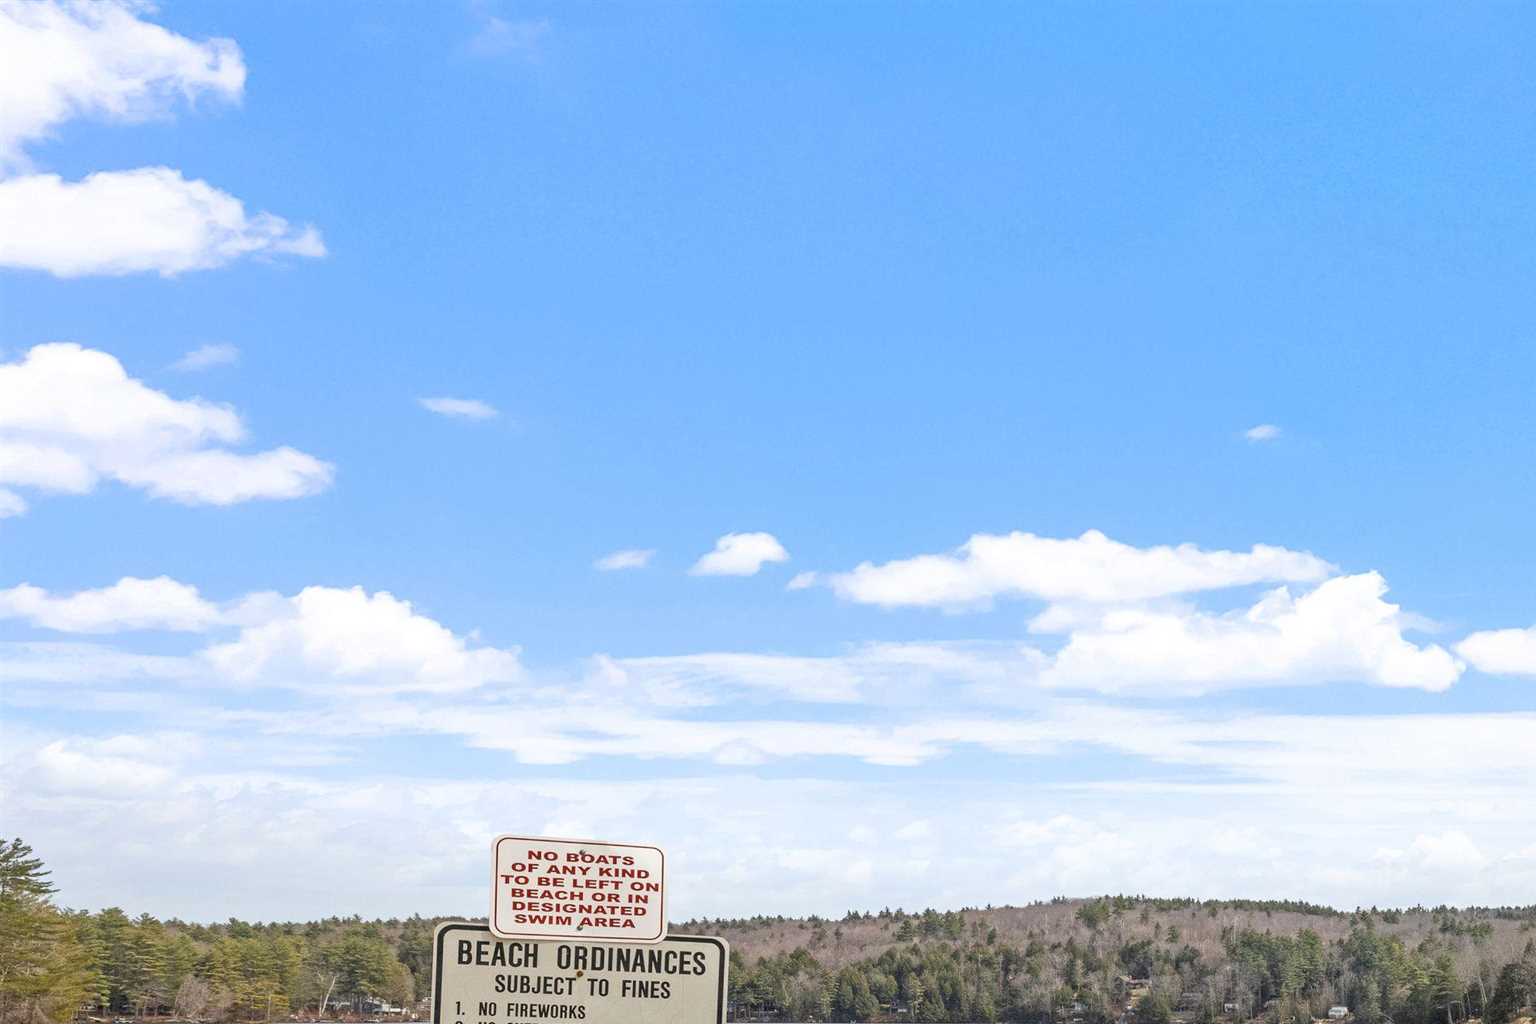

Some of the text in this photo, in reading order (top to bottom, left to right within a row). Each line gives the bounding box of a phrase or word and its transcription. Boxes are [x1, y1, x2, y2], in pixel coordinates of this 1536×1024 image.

[527, 850, 635, 866] NO BOATS
[511, 862, 650, 879] OF ANY KIND
[501, 874, 659, 893] TO BE LEFT ON
[511, 888, 649, 905] BEACH OR IN
[512, 901, 647, 917] DESIGNATED
[514, 914, 636, 929] SWIM AREA
[457, 939, 707, 976] BEACH ORDINANCES
[494, 974, 671, 999] SUBJECT TO FINES
[455, 1001, 586, 1020] 1. NO FIREWORKS
